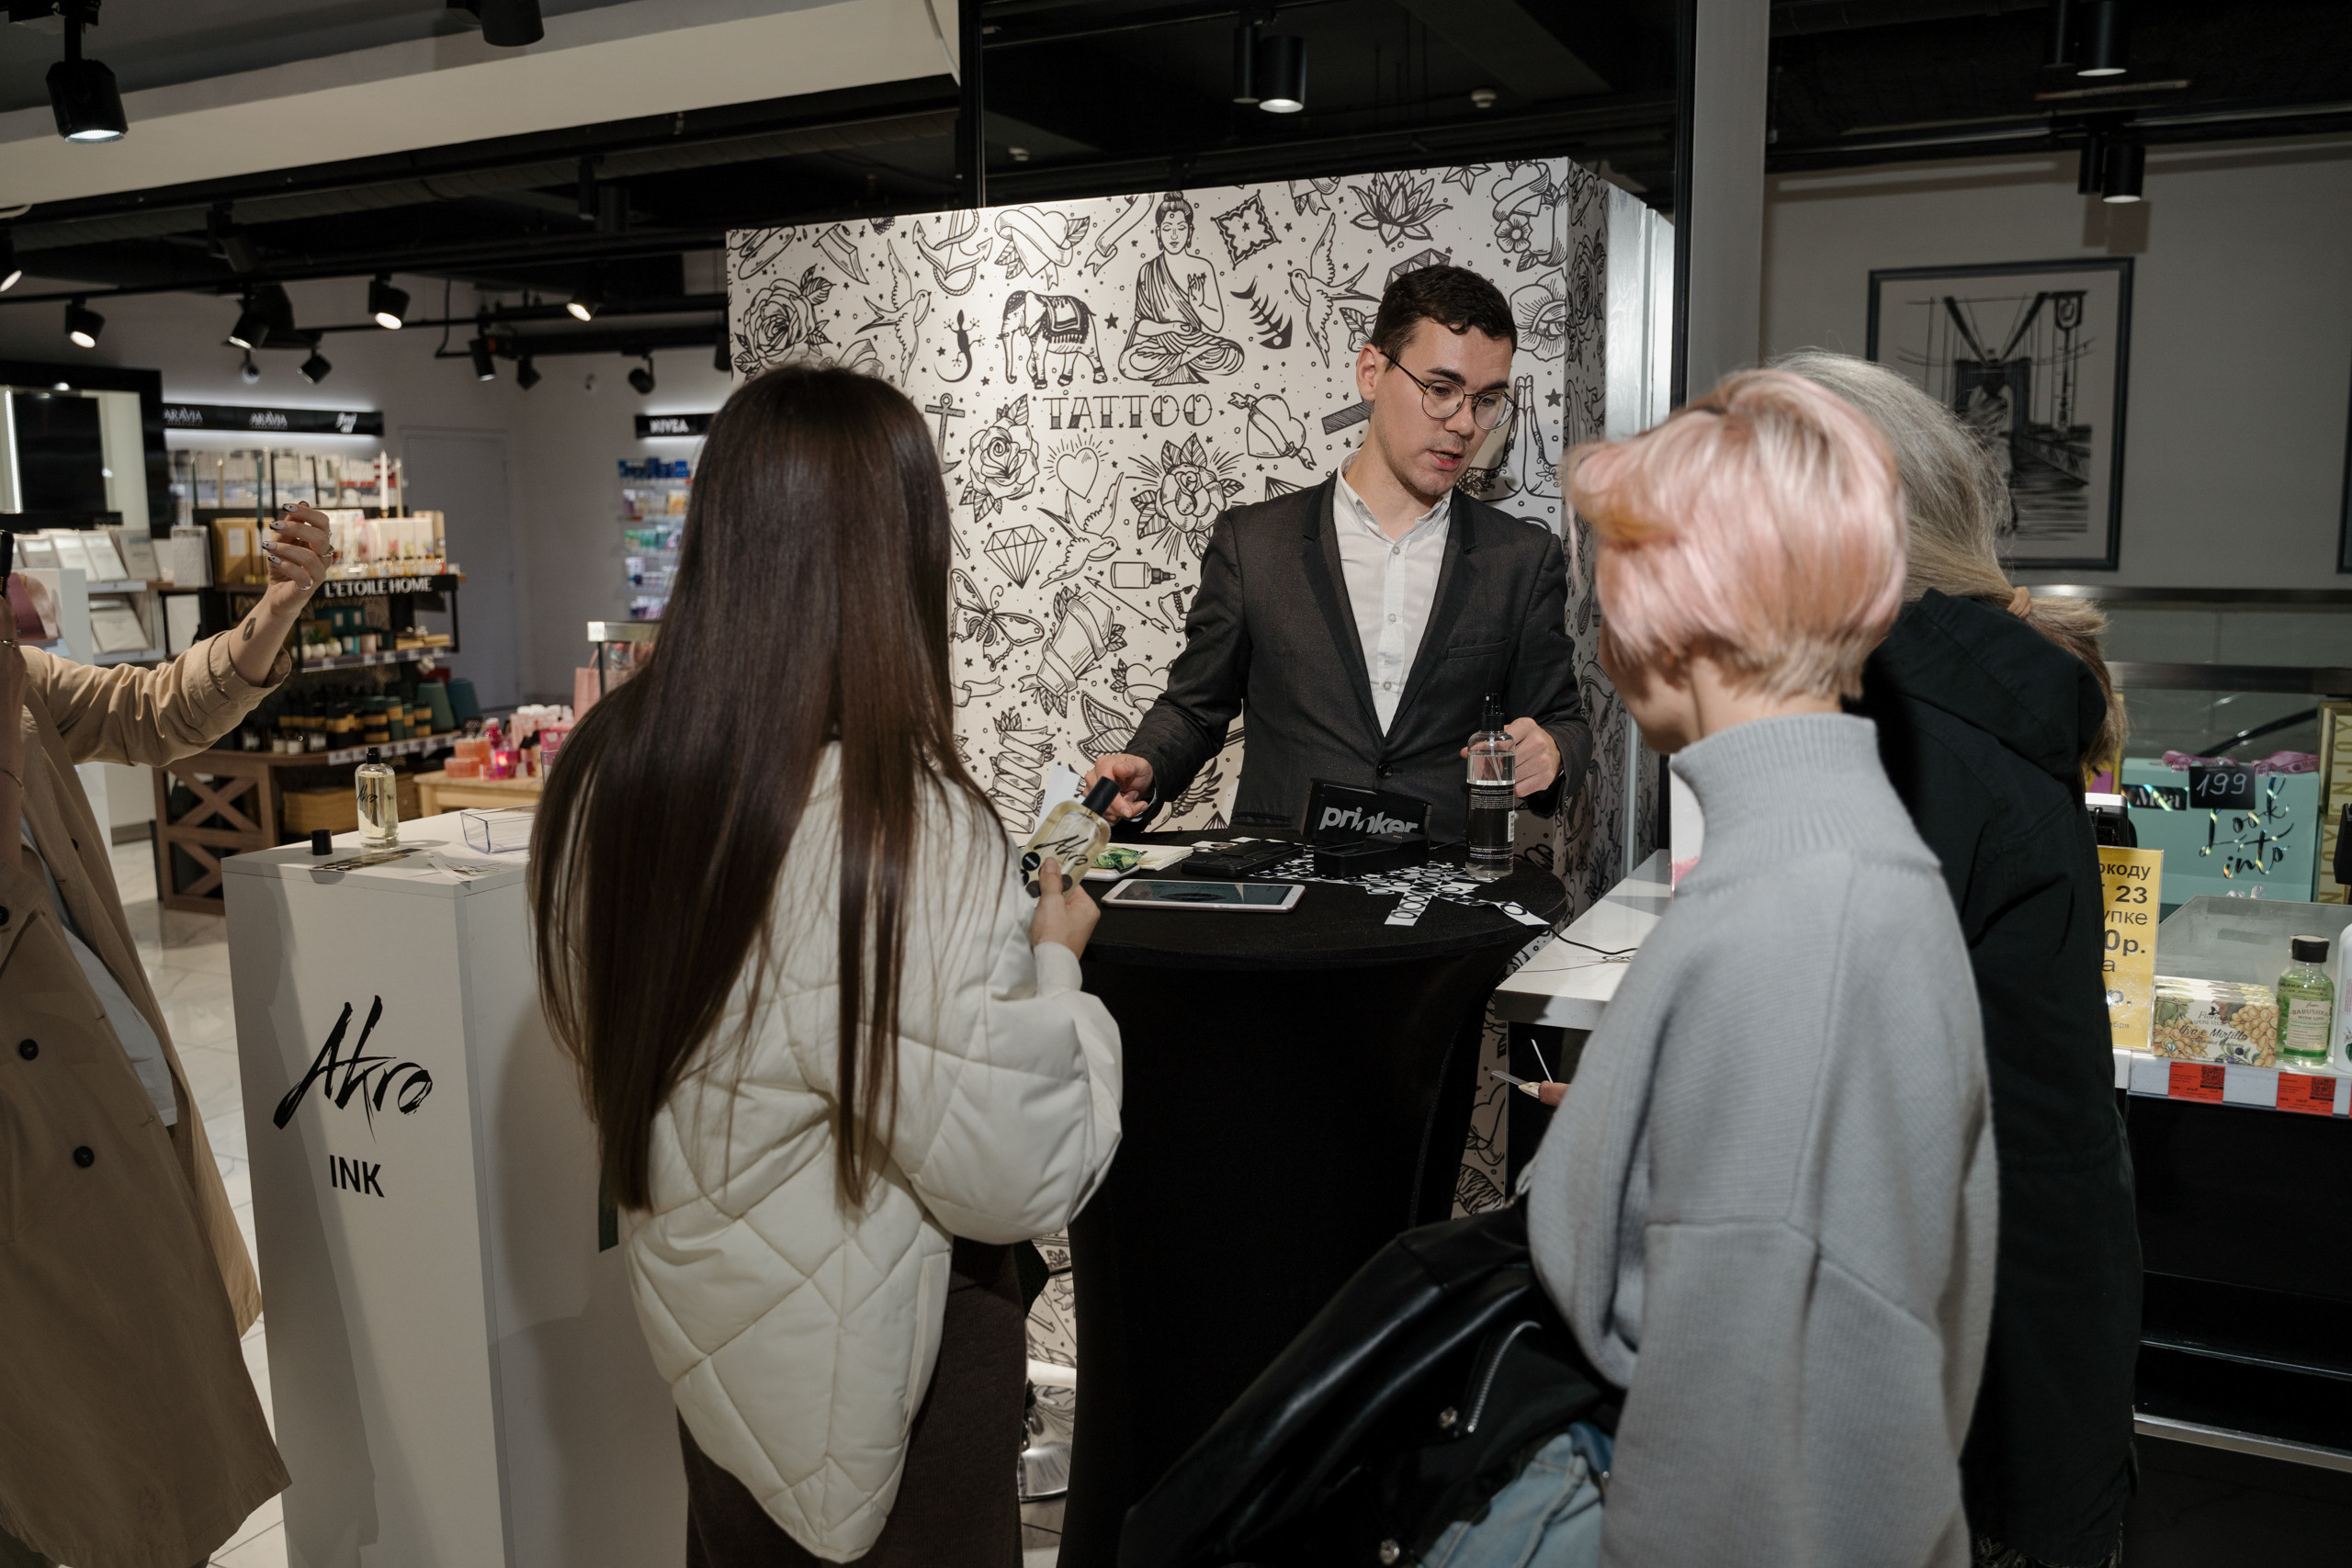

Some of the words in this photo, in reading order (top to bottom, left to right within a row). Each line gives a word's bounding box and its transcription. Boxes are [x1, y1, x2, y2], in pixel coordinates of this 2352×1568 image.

[1043, 394, 1213, 430] TATTOO
[650, 418, 689, 434] NIVEA
[324, 579, 388, 597] L'ETOILE
[389, 576, 433, 594] HOME
[2196, 773, 2247, 797] 199
[1318, 807, 1419, 835] prinker
[2115, 885, 2148, 905] 23
[273, 995, 433, 1145] Akro
[330, 1155, 385, 1198] INK
